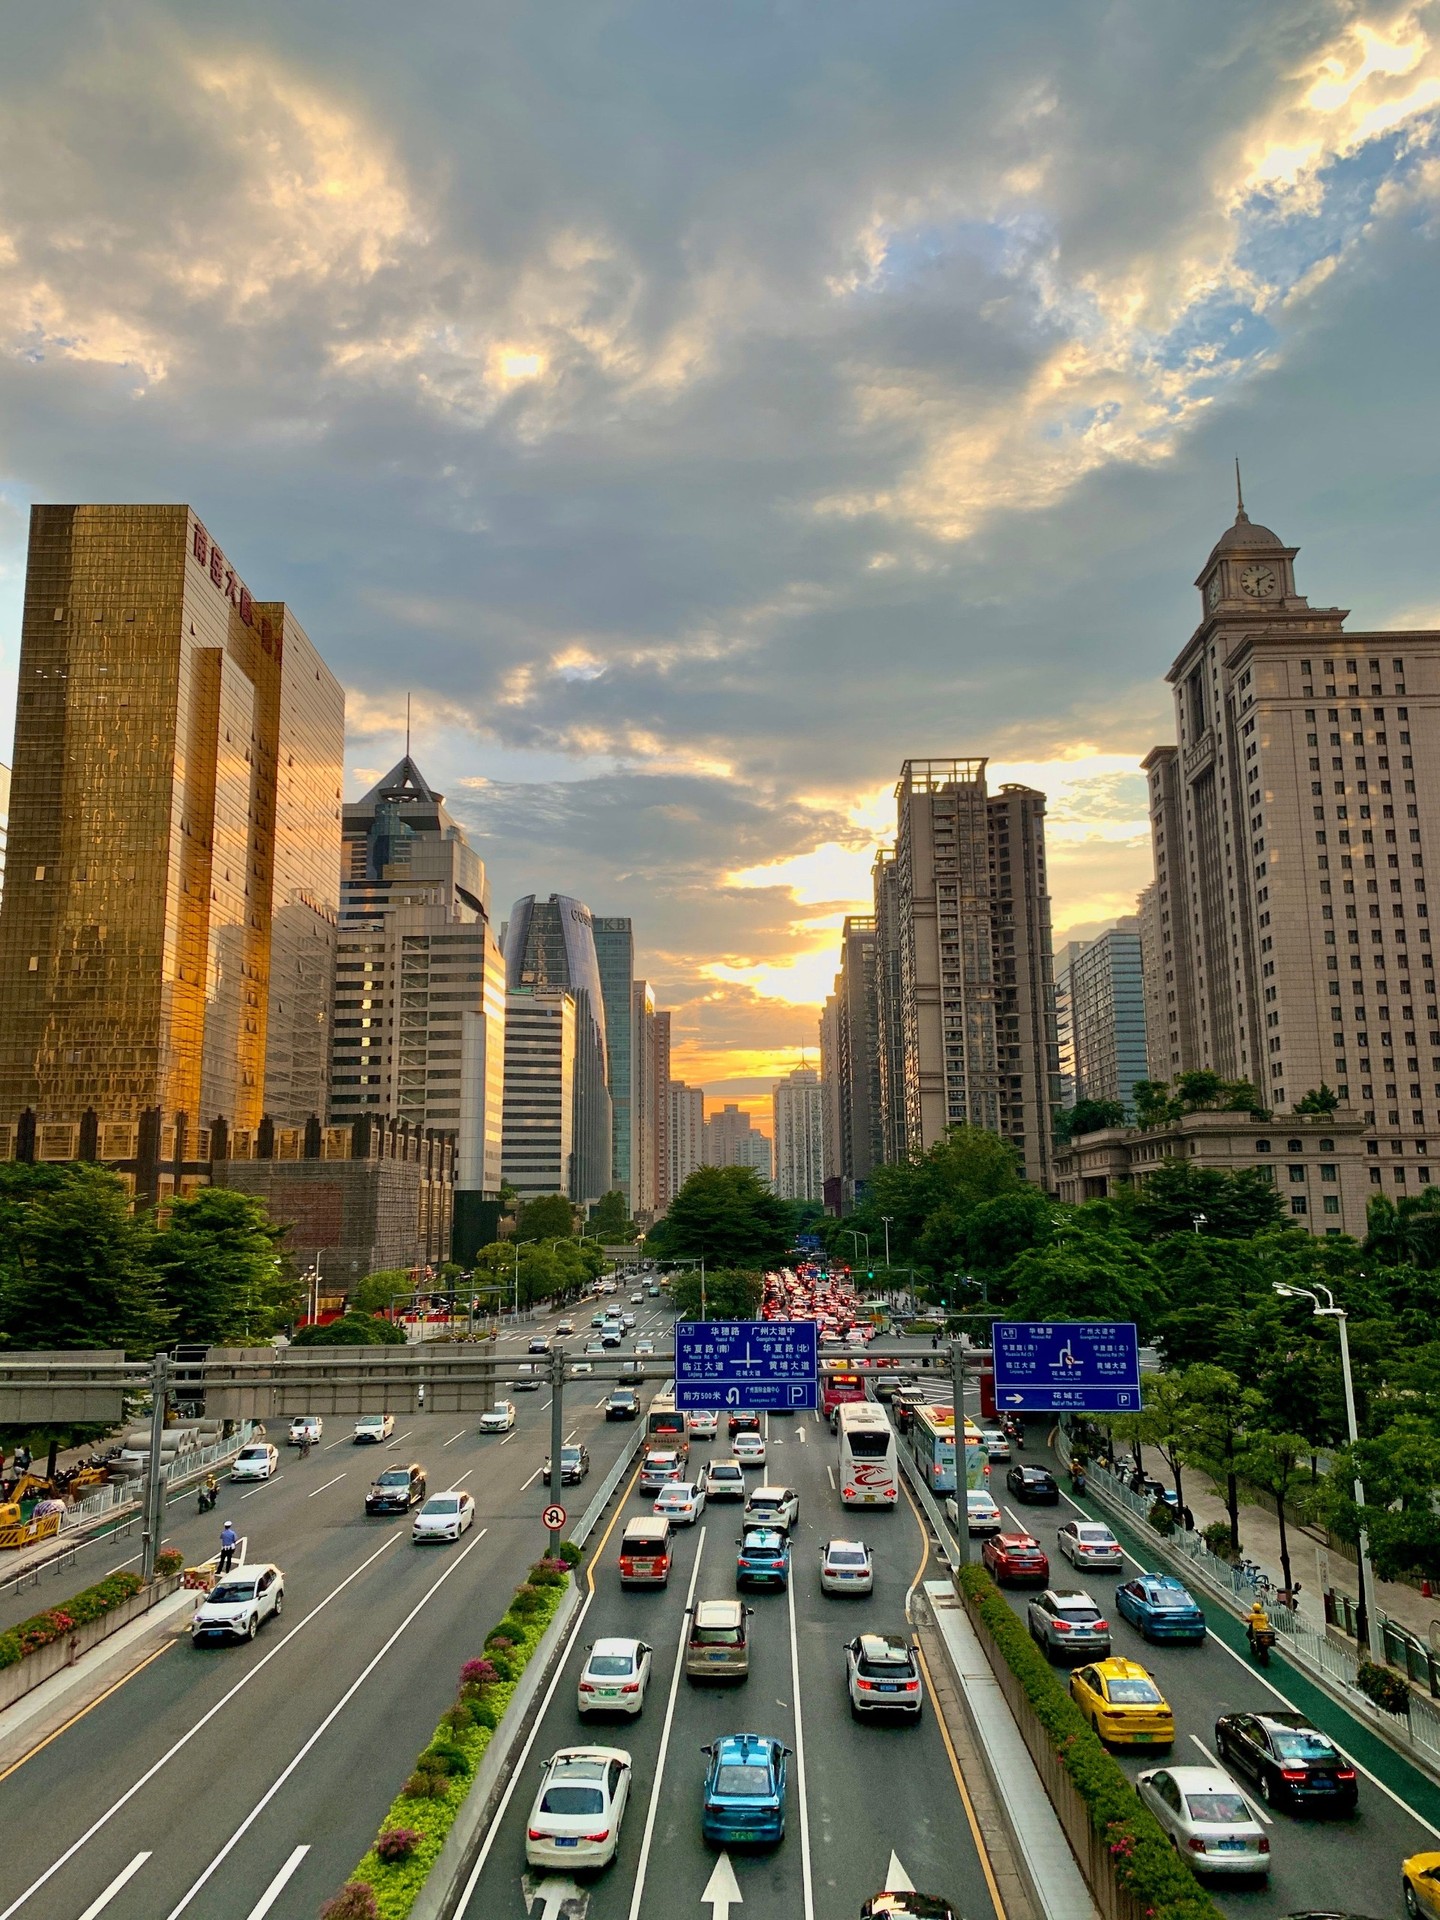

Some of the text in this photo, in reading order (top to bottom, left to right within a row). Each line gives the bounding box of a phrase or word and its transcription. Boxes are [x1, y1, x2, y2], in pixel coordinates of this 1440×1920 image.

[751, 1326, 796, 1336] 广州大道中
[1079, 1327, 1116, 1335] 广州大道中
[762, 1343, 810, 1353] 华夏路(北)
[682, 1362, 724, 1371] 临江大道
[769, 1361, 810, 1371] 黄埔大道
[683, 1391, 721, 1401] 前方500米
[791, 1387, 804, 1404] P
[1120, 1395, 1128, 1404] P
